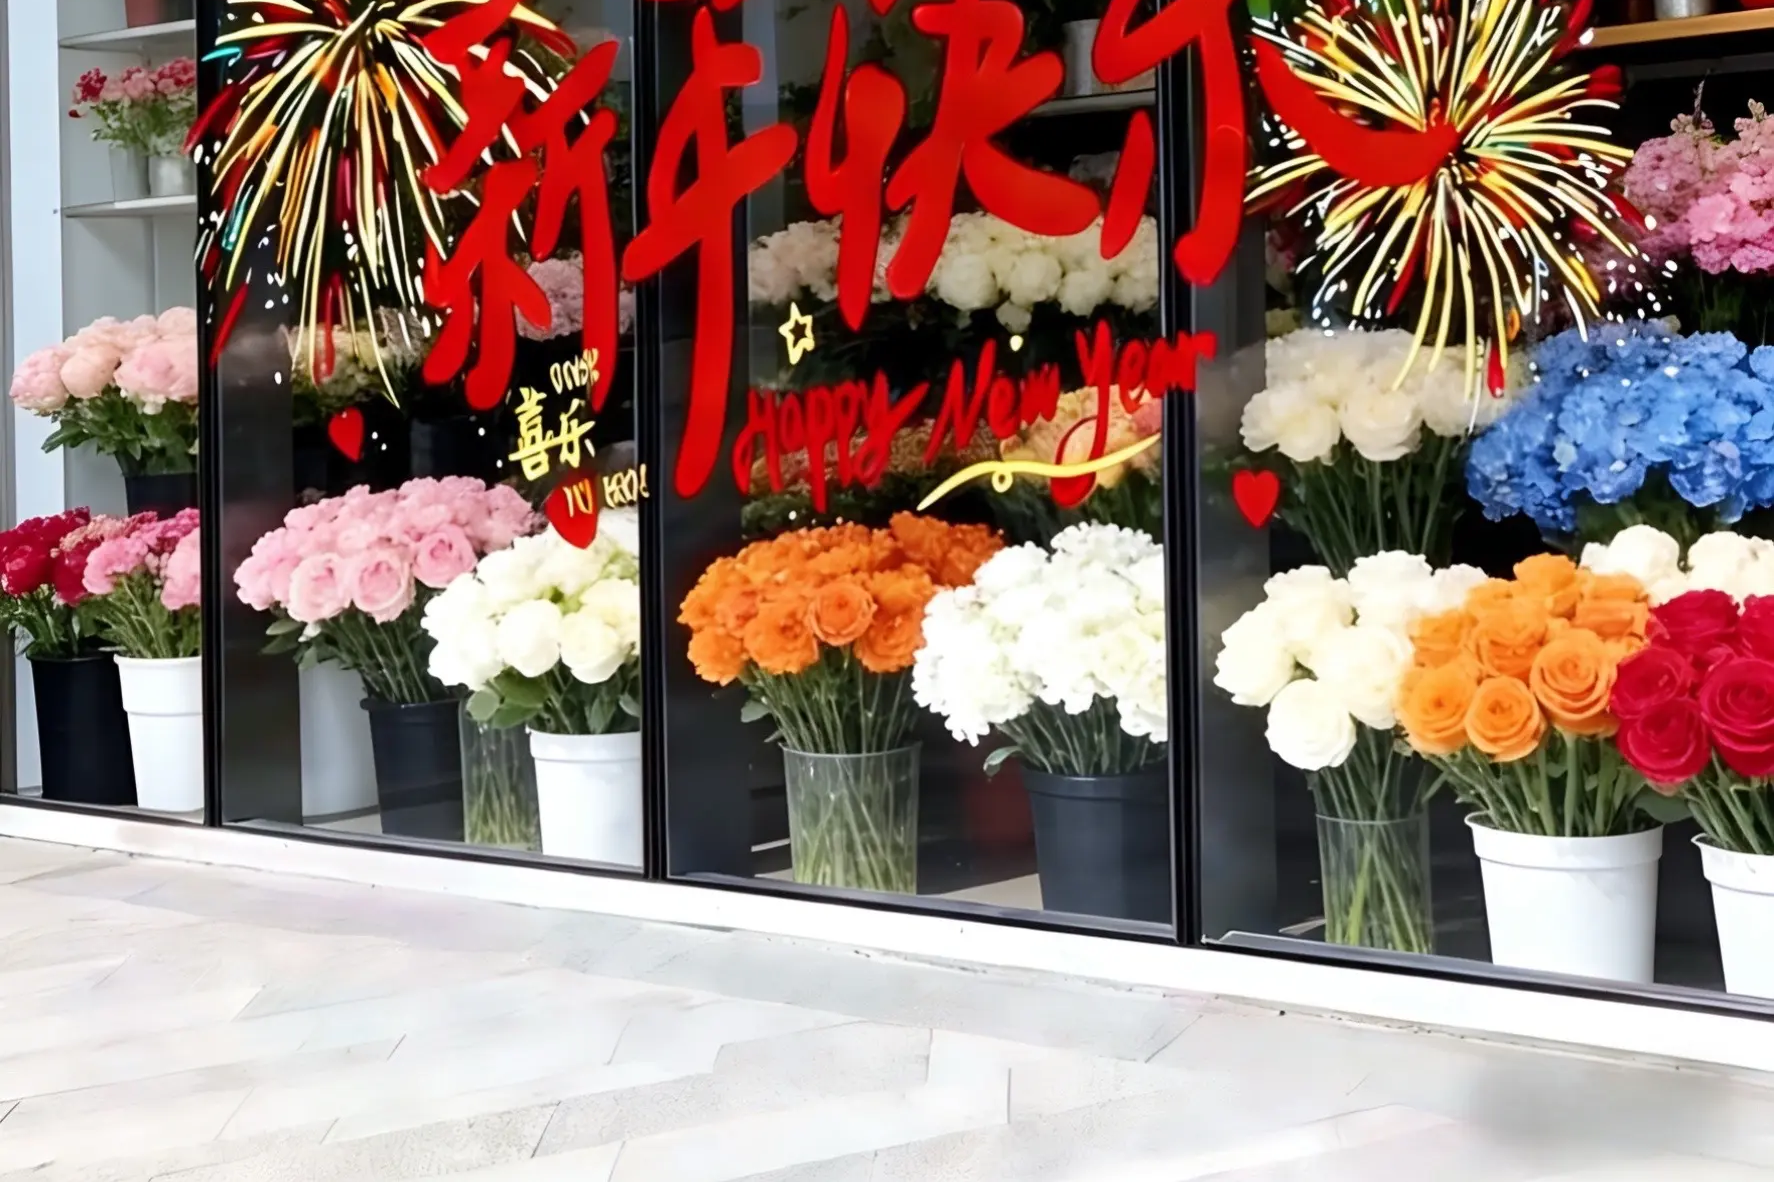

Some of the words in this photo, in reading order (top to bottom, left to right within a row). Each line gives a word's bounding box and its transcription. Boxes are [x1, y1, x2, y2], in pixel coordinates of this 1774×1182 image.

[508, 386, 596, 481] 喜乐
[732, 369, 928, 514] Happy
[922, 338, 1060, 465] New
